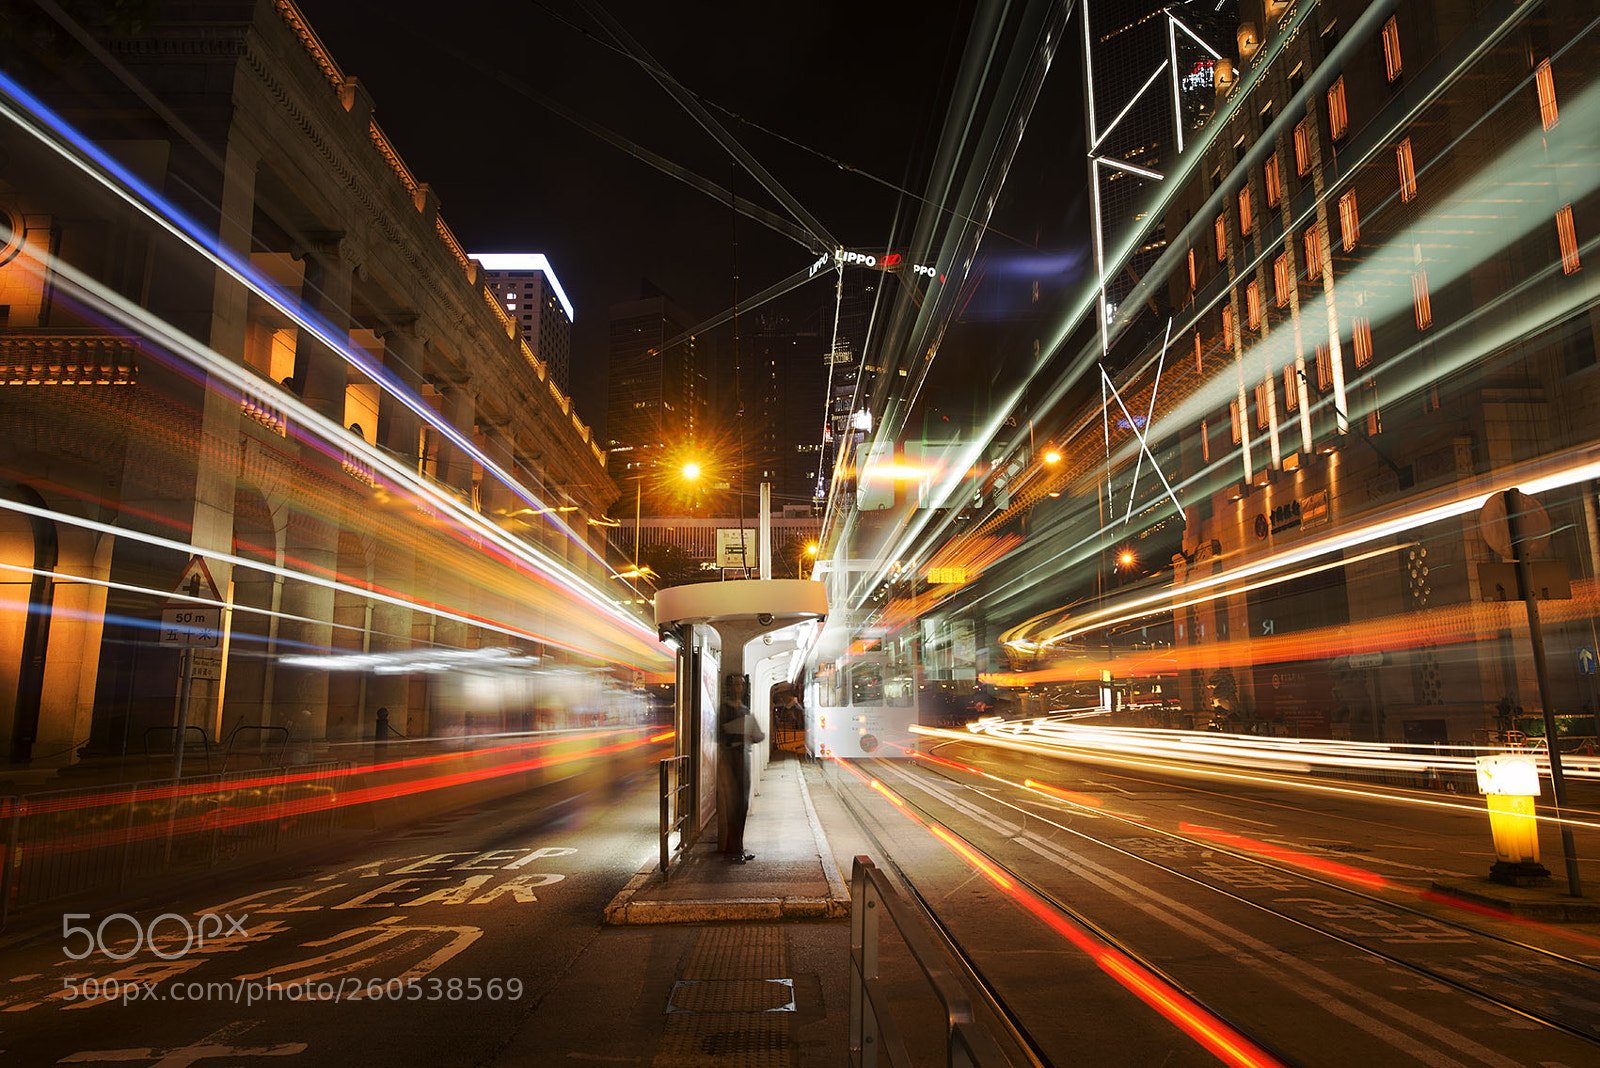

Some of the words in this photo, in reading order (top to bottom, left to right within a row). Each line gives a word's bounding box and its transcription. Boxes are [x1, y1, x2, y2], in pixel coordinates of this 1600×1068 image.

[809, 252, 828, 277] LIPPO
[835, 249, 876, 267] LIPPO
[176, 613, 192, 623] 50
[195, 615, 205, 623] m
[165, 628, 212, 641] 五十米
[315, 847, 579, 880] KEEP
[193, 873, 567, 917] CLEAR
